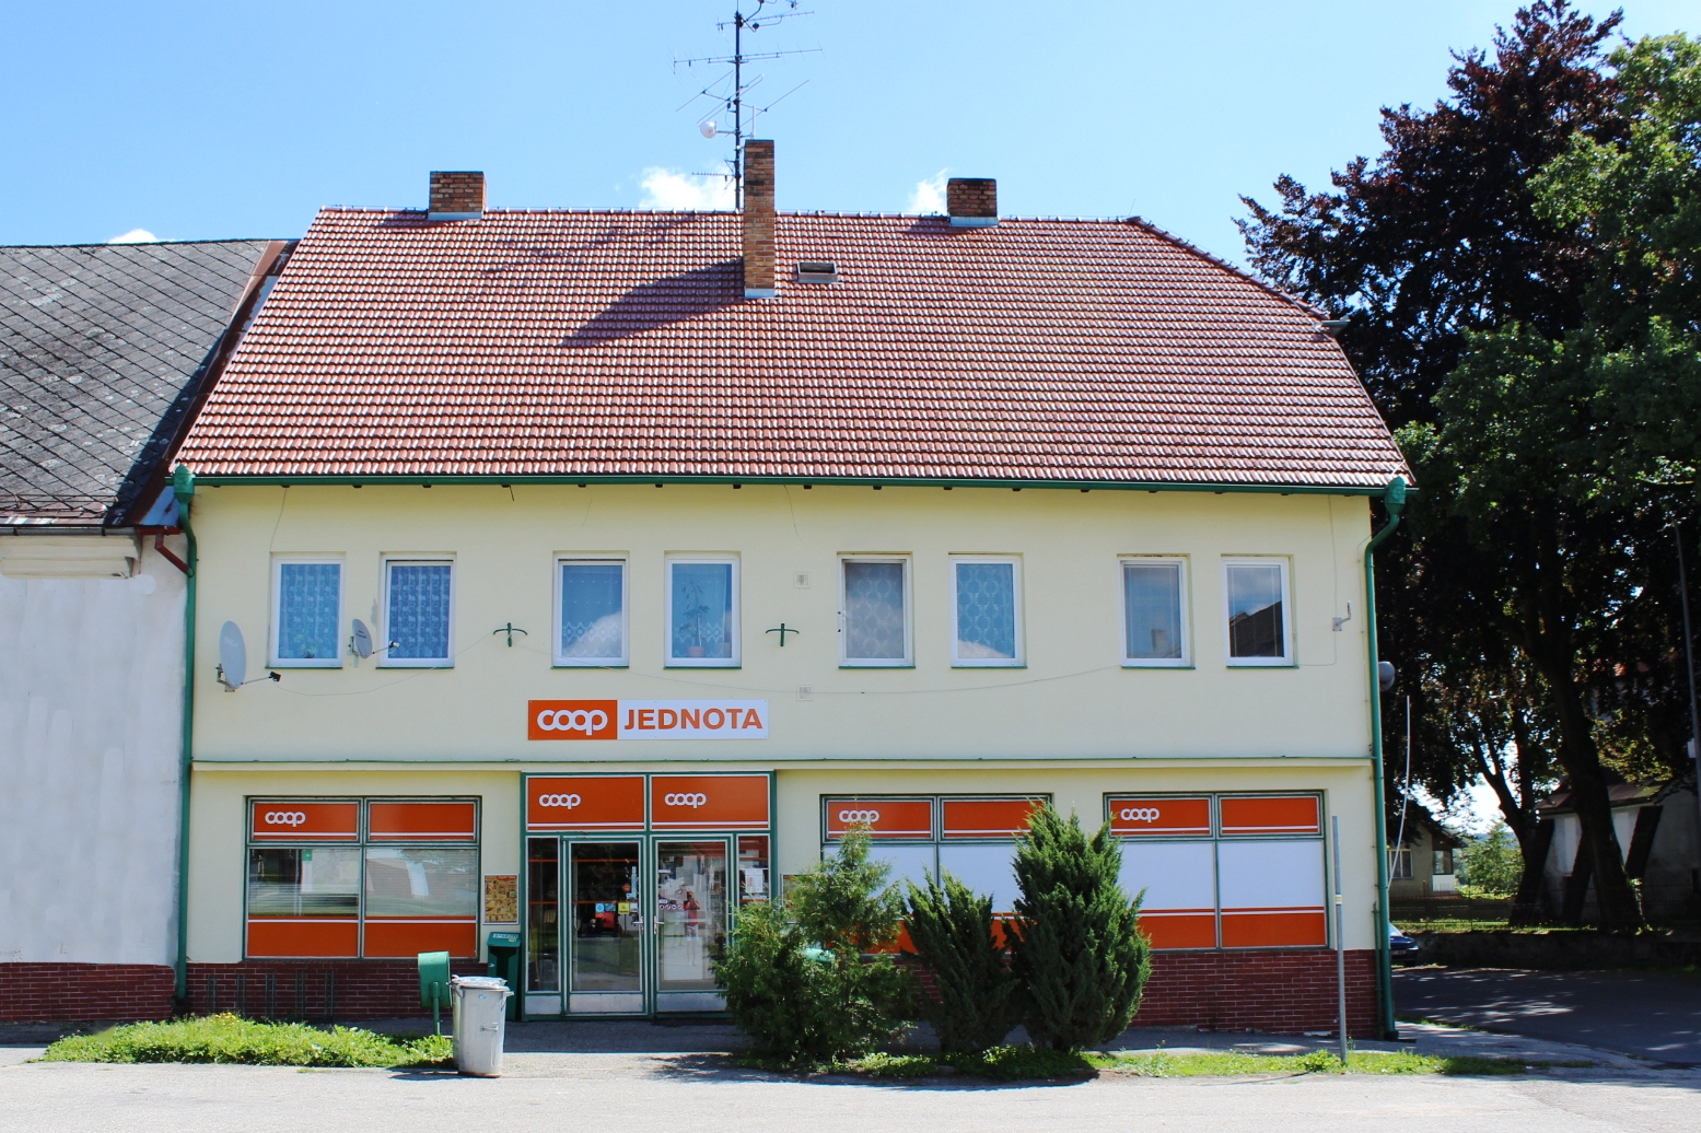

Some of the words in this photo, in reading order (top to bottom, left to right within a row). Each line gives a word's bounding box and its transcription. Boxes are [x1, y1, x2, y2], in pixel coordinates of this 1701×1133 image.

[537, 709, 608, 736] coop
[624, 709, 763, 730] JEDNOTA
[539, 793, 582, 810] coop
[664, 792, 707, 809] coop
[264, 811, 306, 828] coop
[838, 809, 880, 826] coop
[1120, 807, 1160, 823] coop
